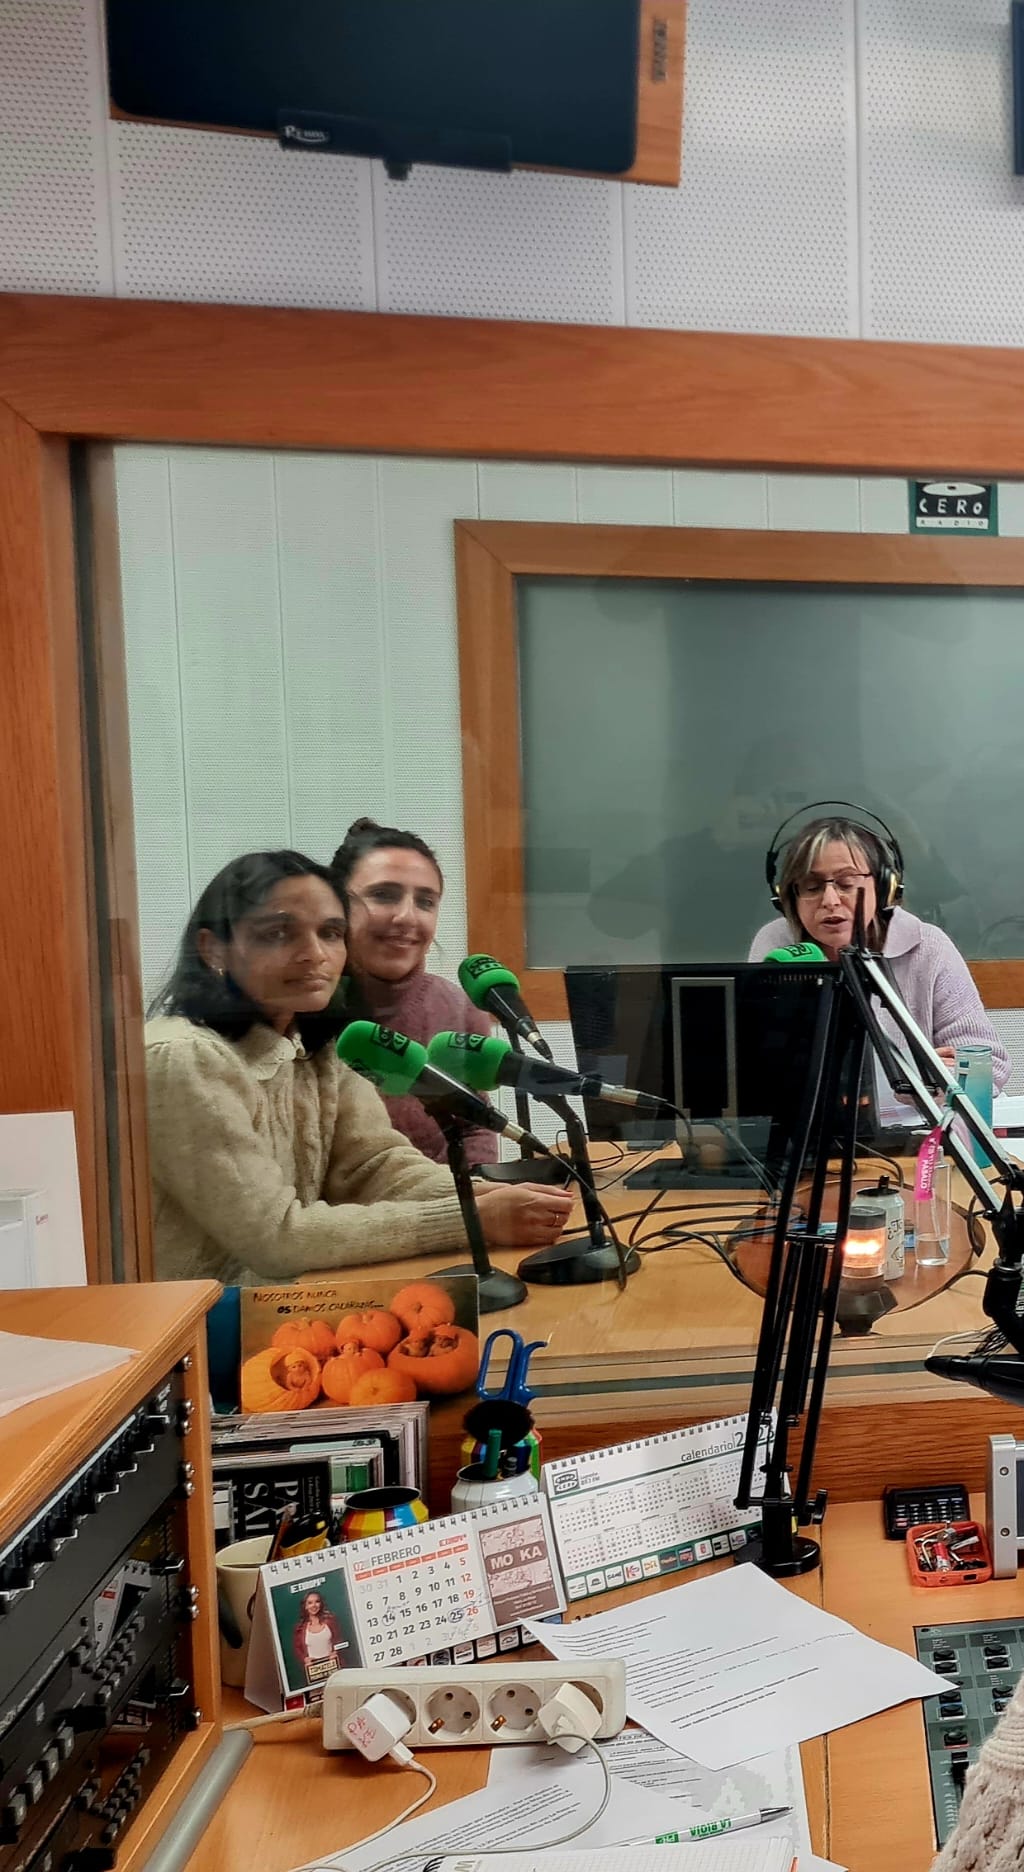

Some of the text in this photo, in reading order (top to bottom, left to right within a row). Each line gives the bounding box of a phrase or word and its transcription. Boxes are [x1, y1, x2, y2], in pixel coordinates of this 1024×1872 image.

[919, 498, 982, 515] CERO
[680, 1442, 733, 1462] calendario
[371, 1544, 421, 1567] FEBRERO
[490, 1545, 543, 1570] MO KA
[412, 1570, 419, 1580] 2
[427, 1566, 435, 1575] 3
[444, 1561, 451, 1570] 4
[459, 1557, 466, 1567] 5
[366, 1573, 472, 1610] 6 7 8 9 10 11 12
[367, 1589, 475, 1628] 13 14 15 16 17 18 19
[369, 1606, 479, 1645] 20 21 22 23 24 25 26
[373, 1651, 385, 1662] 27
[389, 1646, 403, 1657] 28
